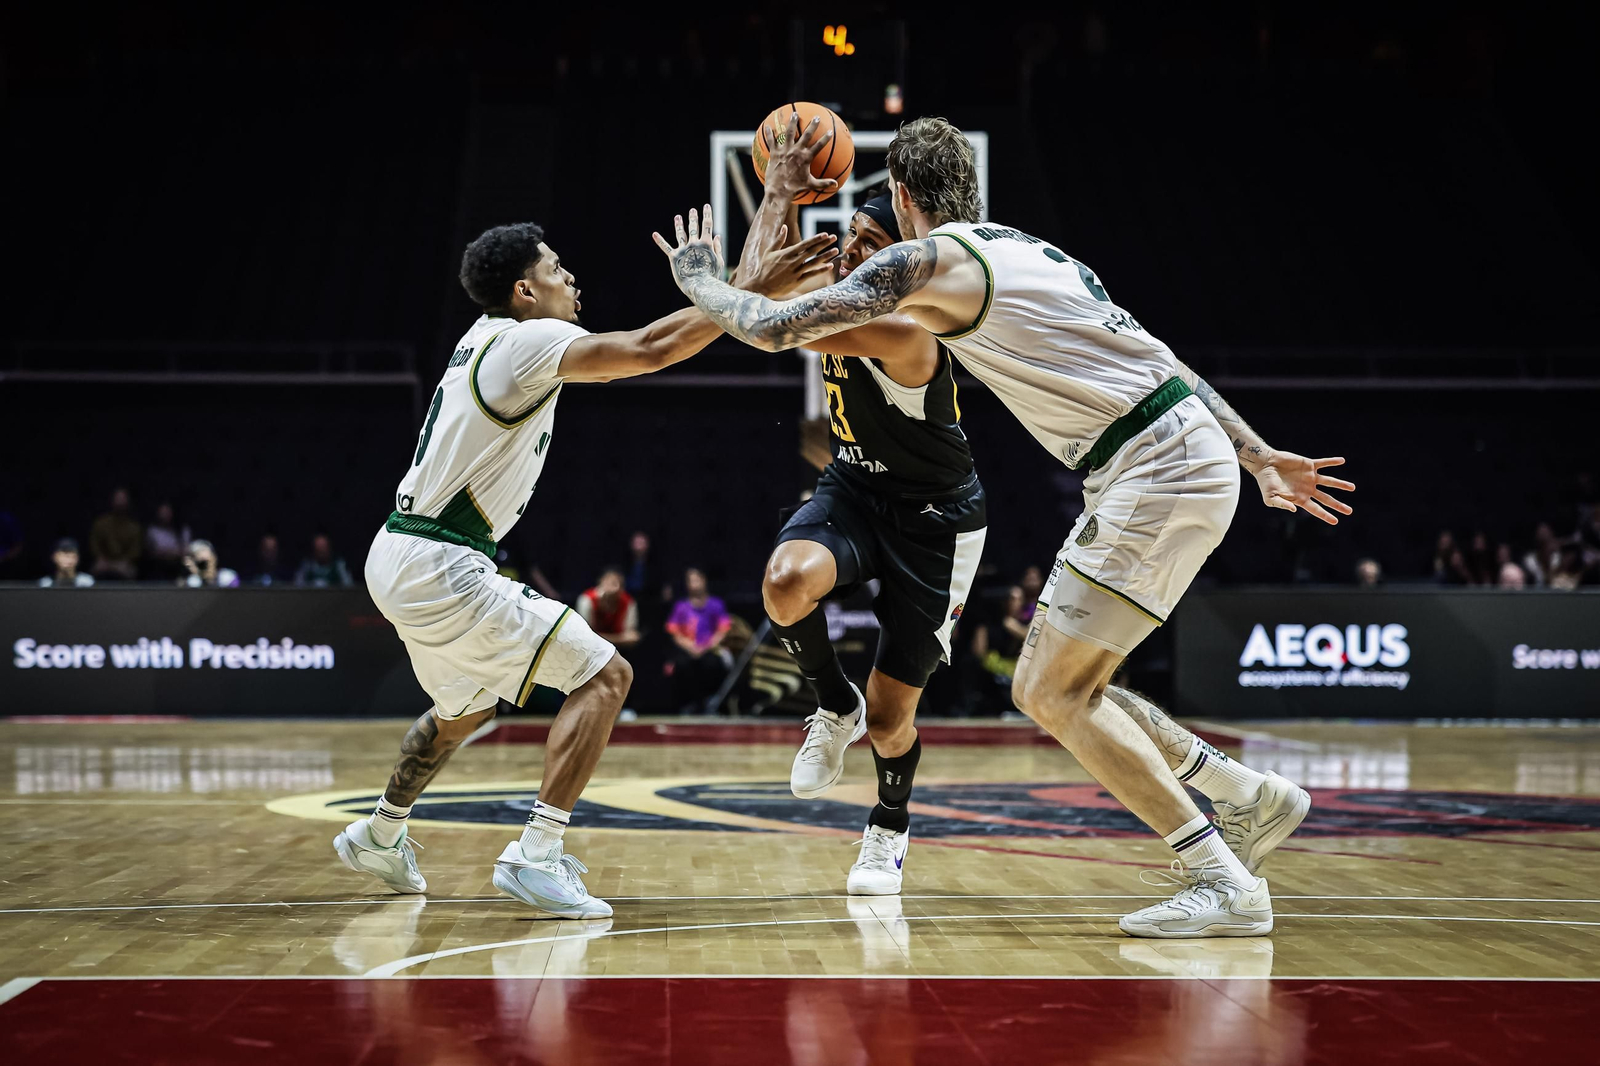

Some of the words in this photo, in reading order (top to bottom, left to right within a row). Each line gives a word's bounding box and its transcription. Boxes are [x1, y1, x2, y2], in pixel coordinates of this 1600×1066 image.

[13, 638, 105, 669] Score
[110, 637, 184, 669] with
[189, 637, 335, 670] Precision
[1239, 623, 1410, 669] AEQUS
[1512, 643, 1578, 670] Score
